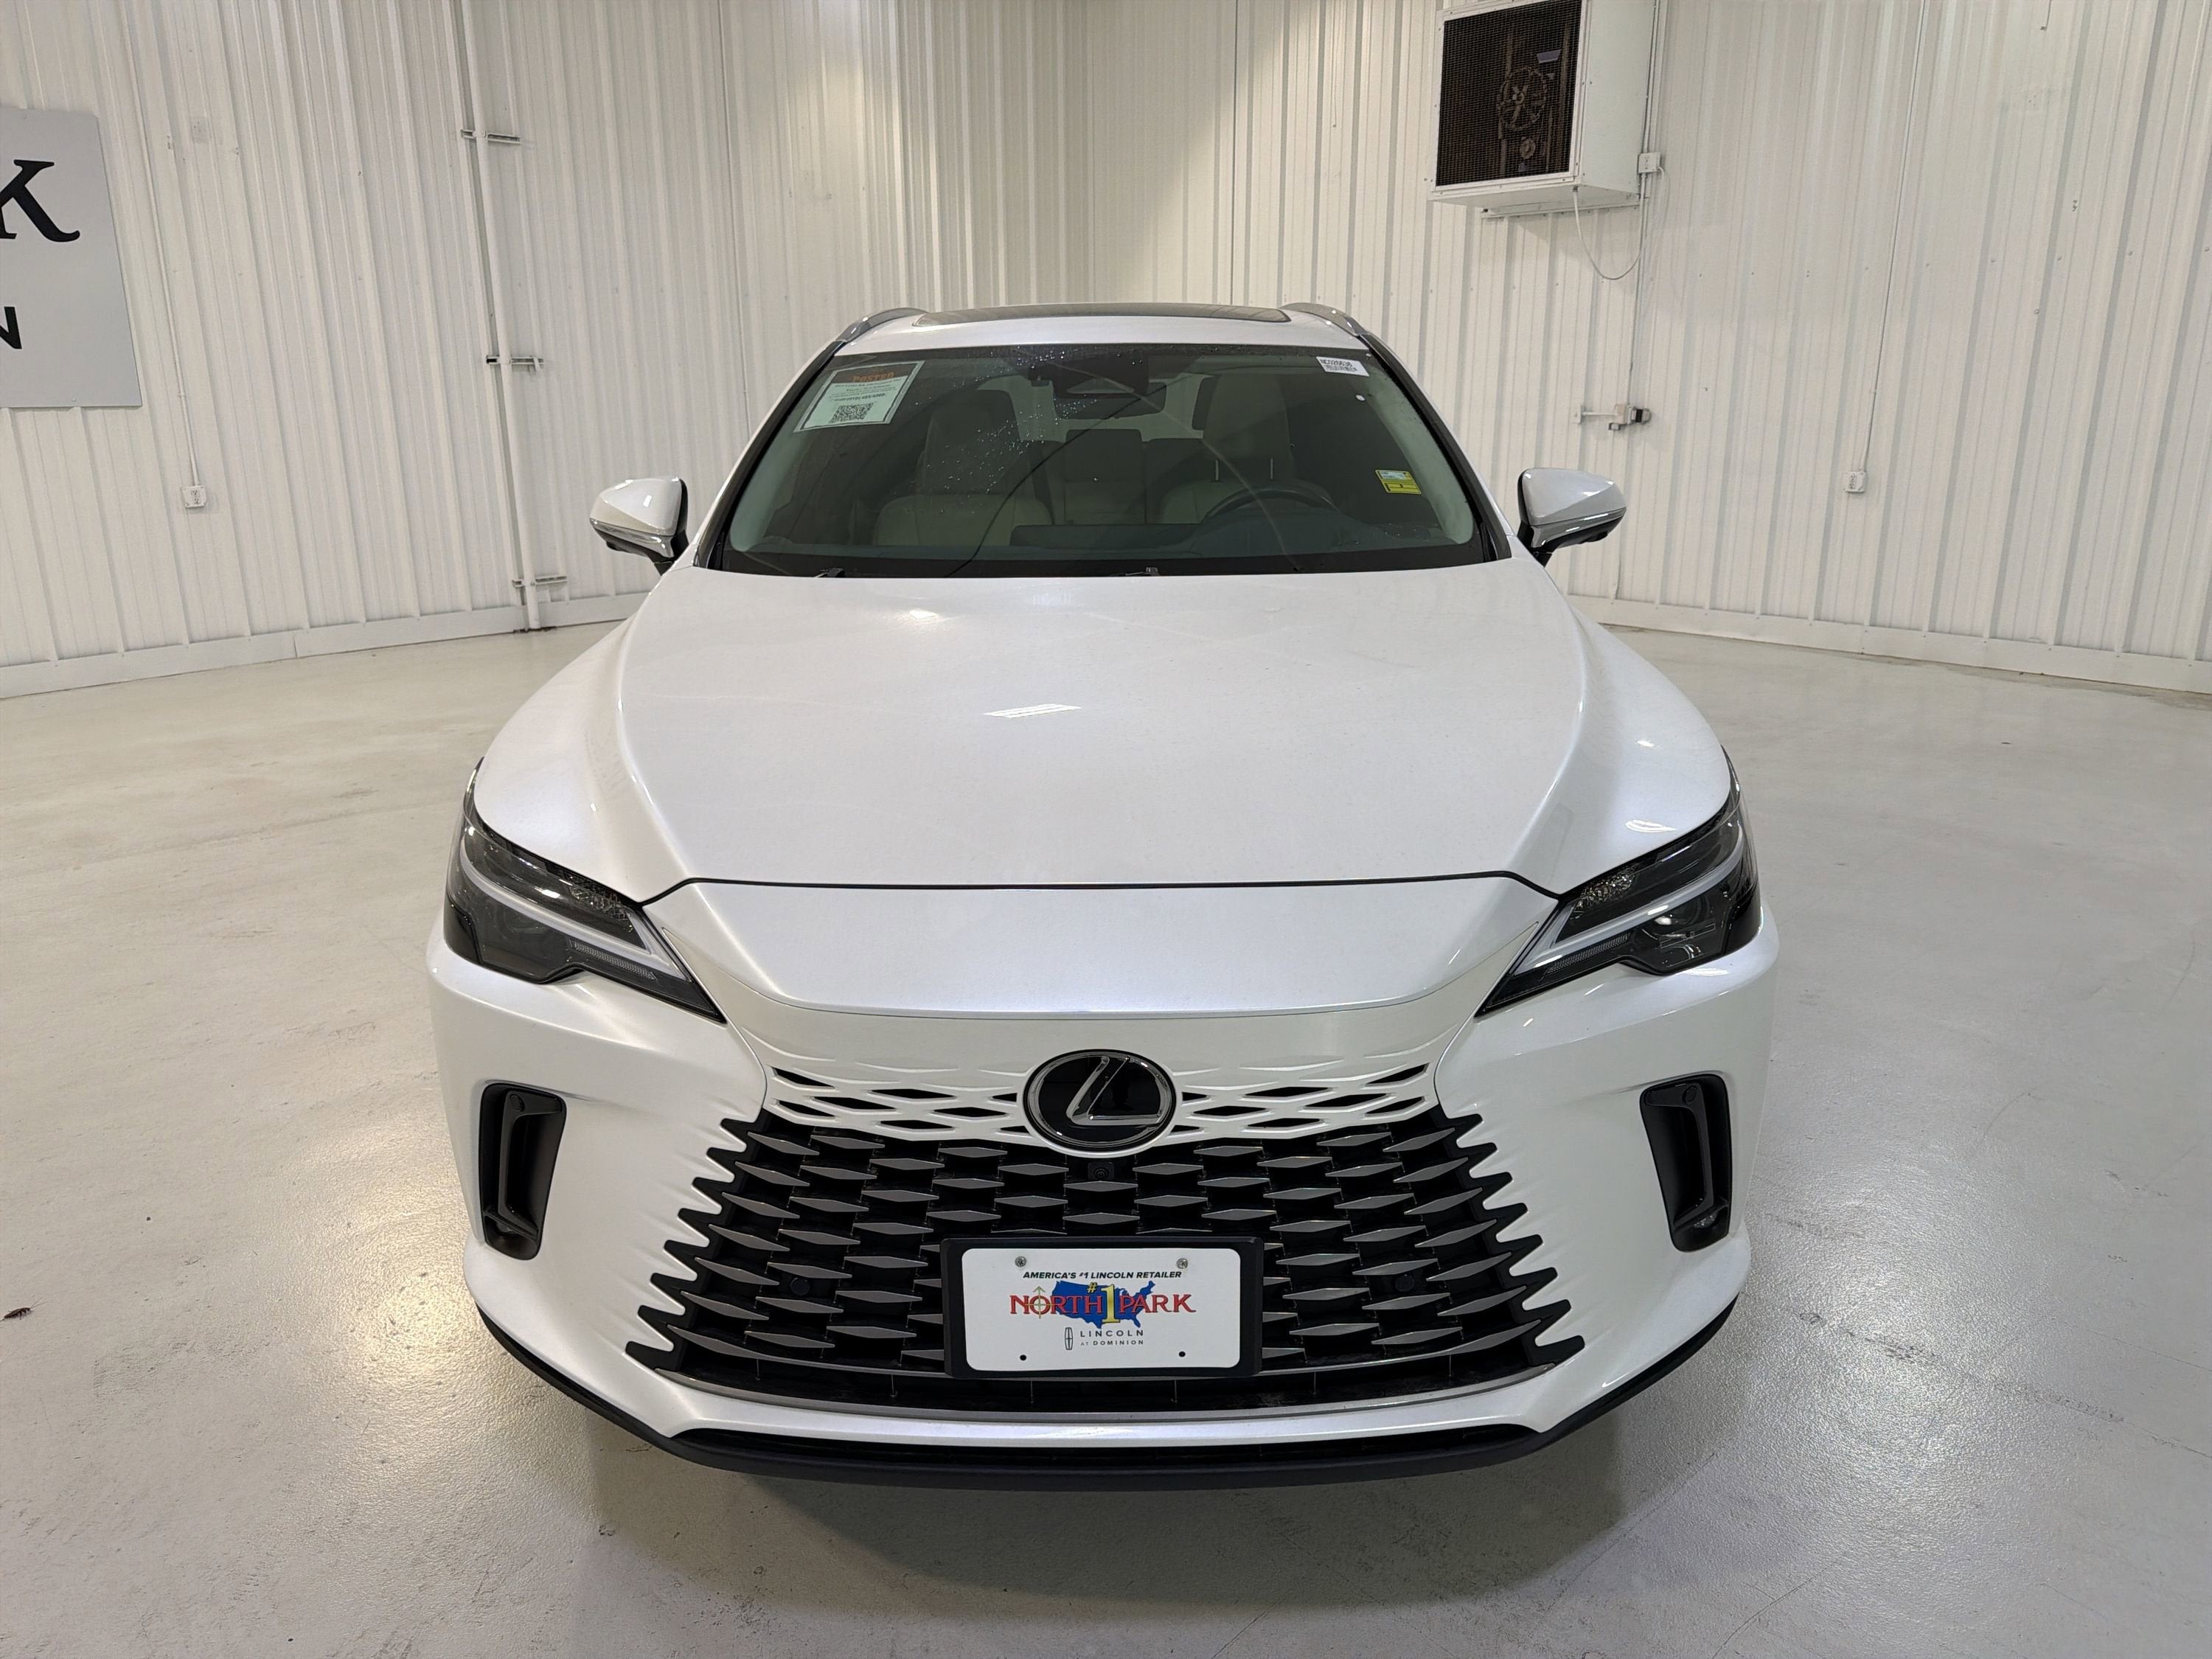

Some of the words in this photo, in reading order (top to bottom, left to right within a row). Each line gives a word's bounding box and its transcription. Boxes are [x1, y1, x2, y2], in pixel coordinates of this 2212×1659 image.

[1023, 1271, 1077, 1279] AMERICA'S
[1079, 1271, 1089, 1279] #1
[1091, 1271, 1134, 1279] LINCOLN
[1136, 1270, 1182, 1279] RETAILER
[1009, 1295, 1104, 1315] NORTH
[1119, 1293, 1197, 1313] PARK
[1080, 1329, 1144, 1338] LINCOLN
